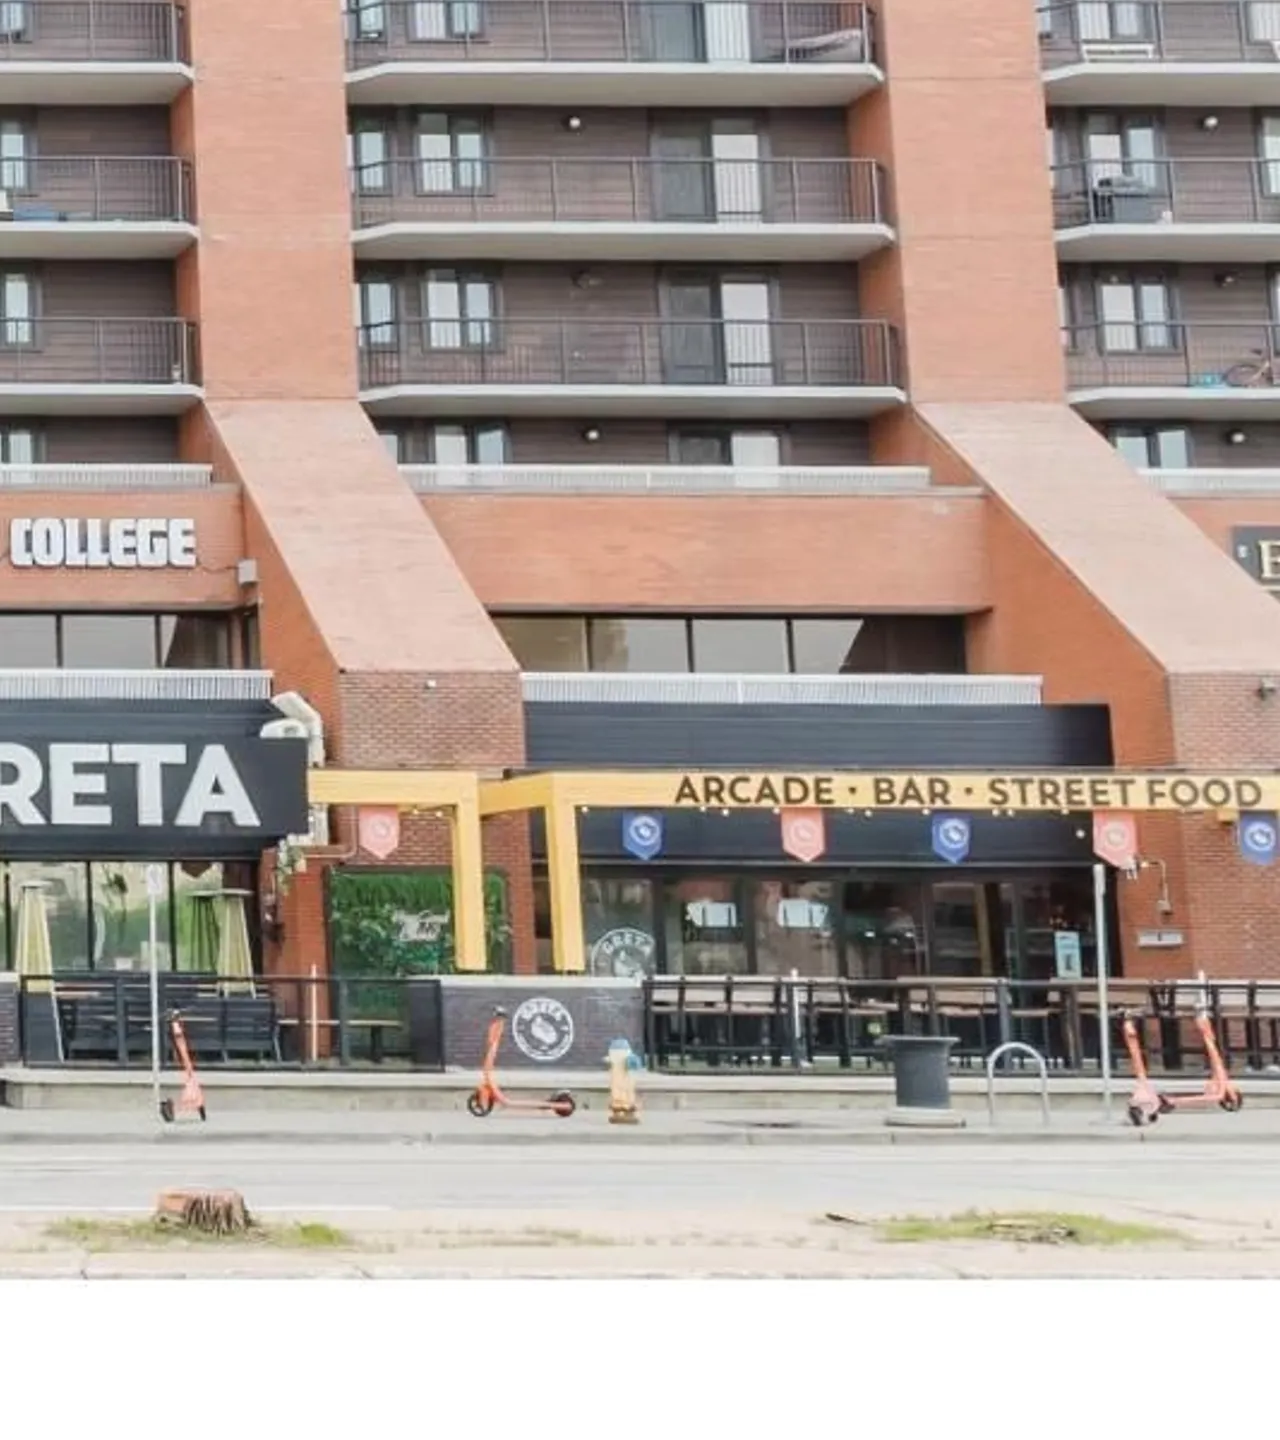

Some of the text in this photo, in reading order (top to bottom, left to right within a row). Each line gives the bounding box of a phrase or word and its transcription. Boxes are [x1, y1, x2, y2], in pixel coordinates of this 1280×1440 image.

[10, 517, 197, 567] COLLEGE
[674, 776, 1263, 807] ARCADE BAR STREET FOOD
